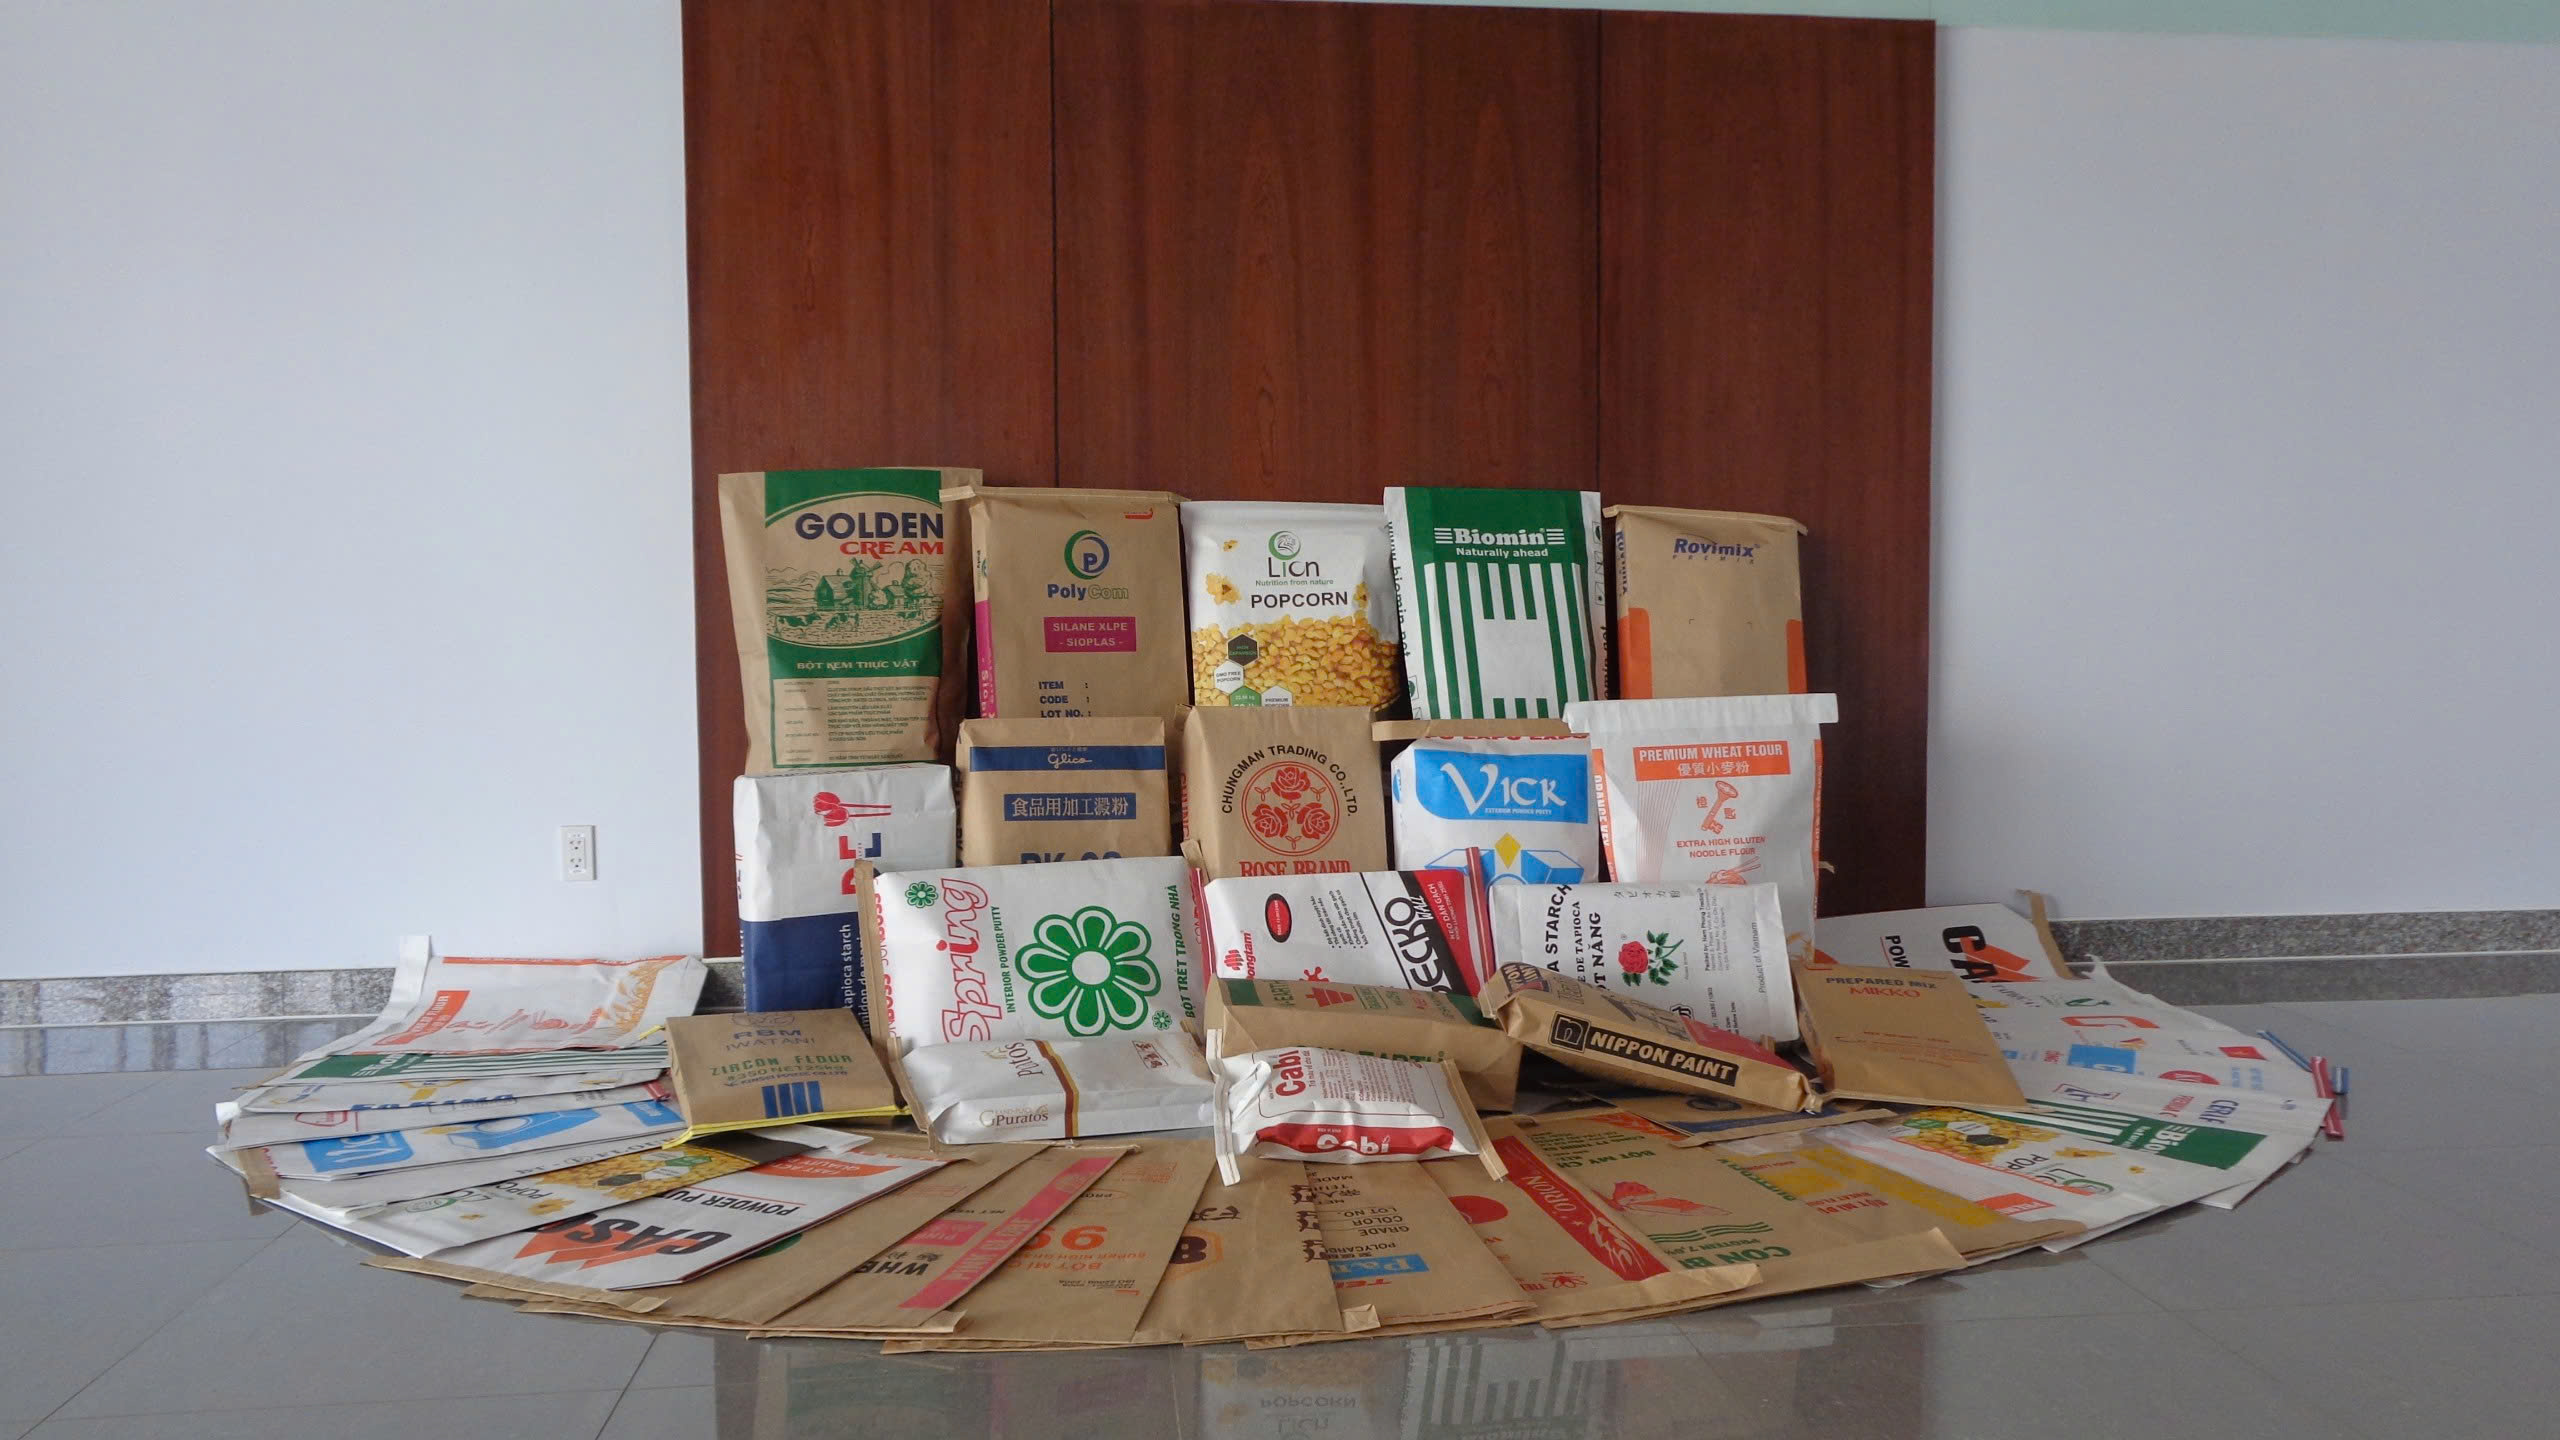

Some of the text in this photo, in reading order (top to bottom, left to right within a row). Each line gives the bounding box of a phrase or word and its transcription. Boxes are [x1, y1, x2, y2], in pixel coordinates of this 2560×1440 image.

[796, 512, 943, 539] GOLDEN
[1453, 528, 1545, 545] Biomin
[840, 542, 943, 558] CREAM
[1457, 548, 1549, 559] Naturally ahead
[1673, 538, 1754, 558] Rovimix
[1048, 584, 1128, 600] PolyCom
[1251, 592, 1347, 609] POPCORN
[1053, 623, 1128, 631] SILANE XLPE
[1067, 638, 1115, 646] SIOPLAS
[827, 660, 852, 670] KEM
[1040, 696, 1068, 704] CODE
[1041, 710, 1083, 718] LOT NO.
[1640, 744, 1783, 762] PREMIUM WHEAT FLOUR
[1222, 750, 1265, 814] CHUNGMAN
[1268, 745, 1327, 765] TRADING
[1677, 836, 1766, 848] EXTRA HIGH GLUTEN
[1690, 848, 1756, 858] NOODLE FLOUR
[1545, 884, 1572, 955] STARCH
[1171, 910, 1188, 957] TRONG
[1572, 901, 1585, 973] DE TAPIOCA
[1588, 912, 1605, 968] NĂNG
[1752, 922, 1760, 951] Vietnam
[1384, 896, 1452, 994] ECKO
[1885, 935, 1910, 968] POW
[936, 878, 1003, 1043] Spring
[991, 906, 1016, 1013] INTERIOR POWDER PUTTY
[1245, 932, 1257, 979] ongtam
[1942, 925, 1998, 983] CA
[840, 924, 853, 1008] tapioca starch
[1758, 966, 1766, 993] Product
[1826, 977, 1937, 989] PREPARED MIX
[1849, 987, 1921, 998] MIKKO
[734, 1030, 801, 1040] RBM
[726, 1038, 816, 1051] IWATANI
[1590, 1031, 1734, 1080] NIPPON PAINT
[710, 1055, 853, 1076] ZIRCON FLOUR
[770, 1065, 801, 1073] NET
[1275, 1050, 1307, 1097] Cabi
[996, 1111, 1049, 1127] Puratos
[2005, 1153, 2049, 1171] POP
[1313, 1175, 1352, 1183] MADE
[658, 1186, 802, 1218] POWDER PU
[1524, 1174, 1578, 1214] ORION
[1337, 1209, 1364, 1217] NO.
[1352, 1215, 1403, 1226] COLOR
[1358, 1225, 1409, 1236] GRADE
[1325, 1242, 1396, 1256] POLYCARB
[1697, 1238, 1760, 1250] PROTEIN
[1718, 1246, 1791, 1263] CON
[855, 1261, 930, 1276] WHE
